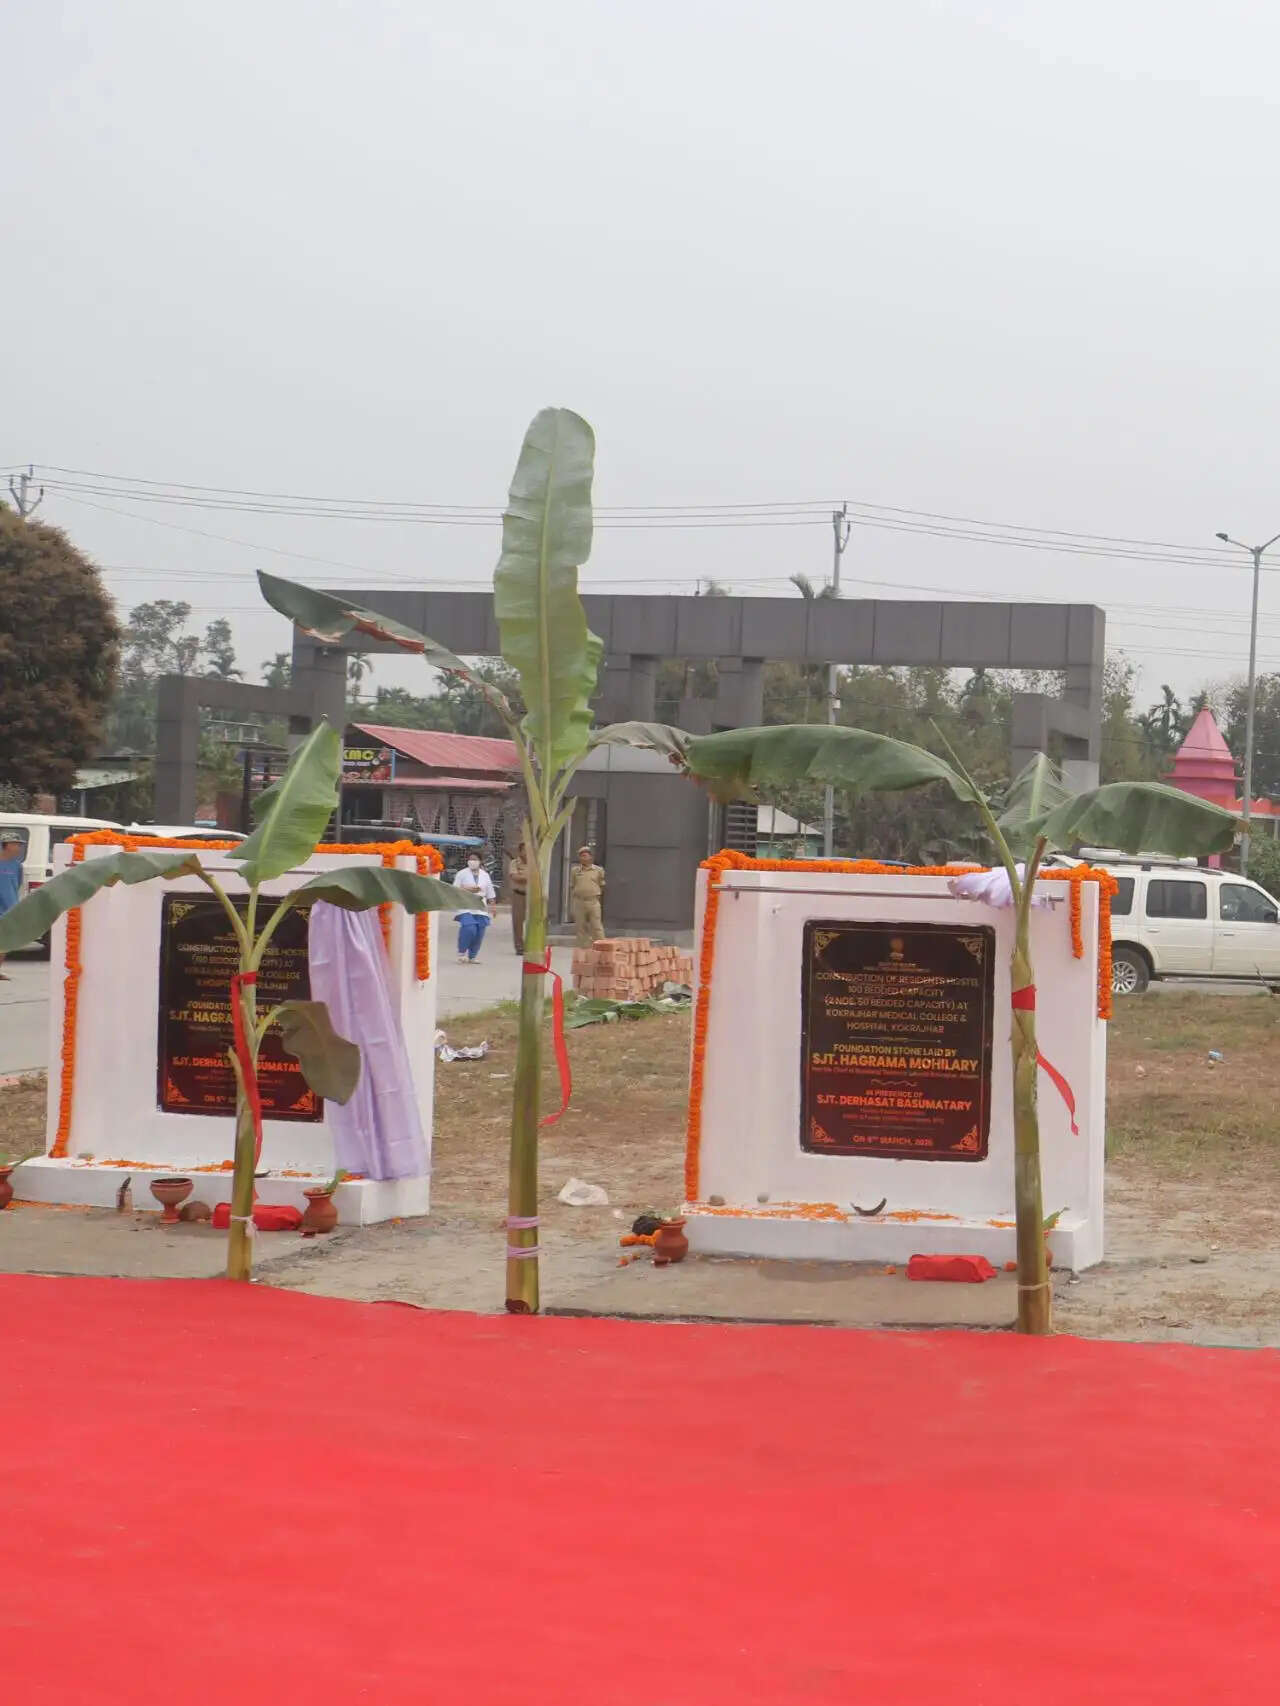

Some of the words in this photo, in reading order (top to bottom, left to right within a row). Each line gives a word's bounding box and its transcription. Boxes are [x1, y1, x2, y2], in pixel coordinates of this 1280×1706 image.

[865, 986, 898, 995] BEDDED
[871, 998, 906, 1007] BEDDED
[193, 1011, 233, 1023] HAGRA
[825, 1009, 878, 1018] KOKRAJHAR
[879, 1010, 917, 1020] MEDICAL
[920, 1013, 958, 1022] COLLEGE
[833, 1043, 892, 1055] FOUNDATION
[894, 1046, 922, 1055] STONE
[923, 1047, 944, 1056] LAID
[945, 1048, 958, 1057] BY
[812, 1053, 838, 1065] SJT.
[840, 1055, 906, 1068] HAGRAMA
[909, 1058, 978, 1072] MOHILARY
[817, 1094, 838, 1104] SJT.
[840, 1095, 895, 1107] DERHASAT
[897, 1098, 972, 1111] BASUMATARY
